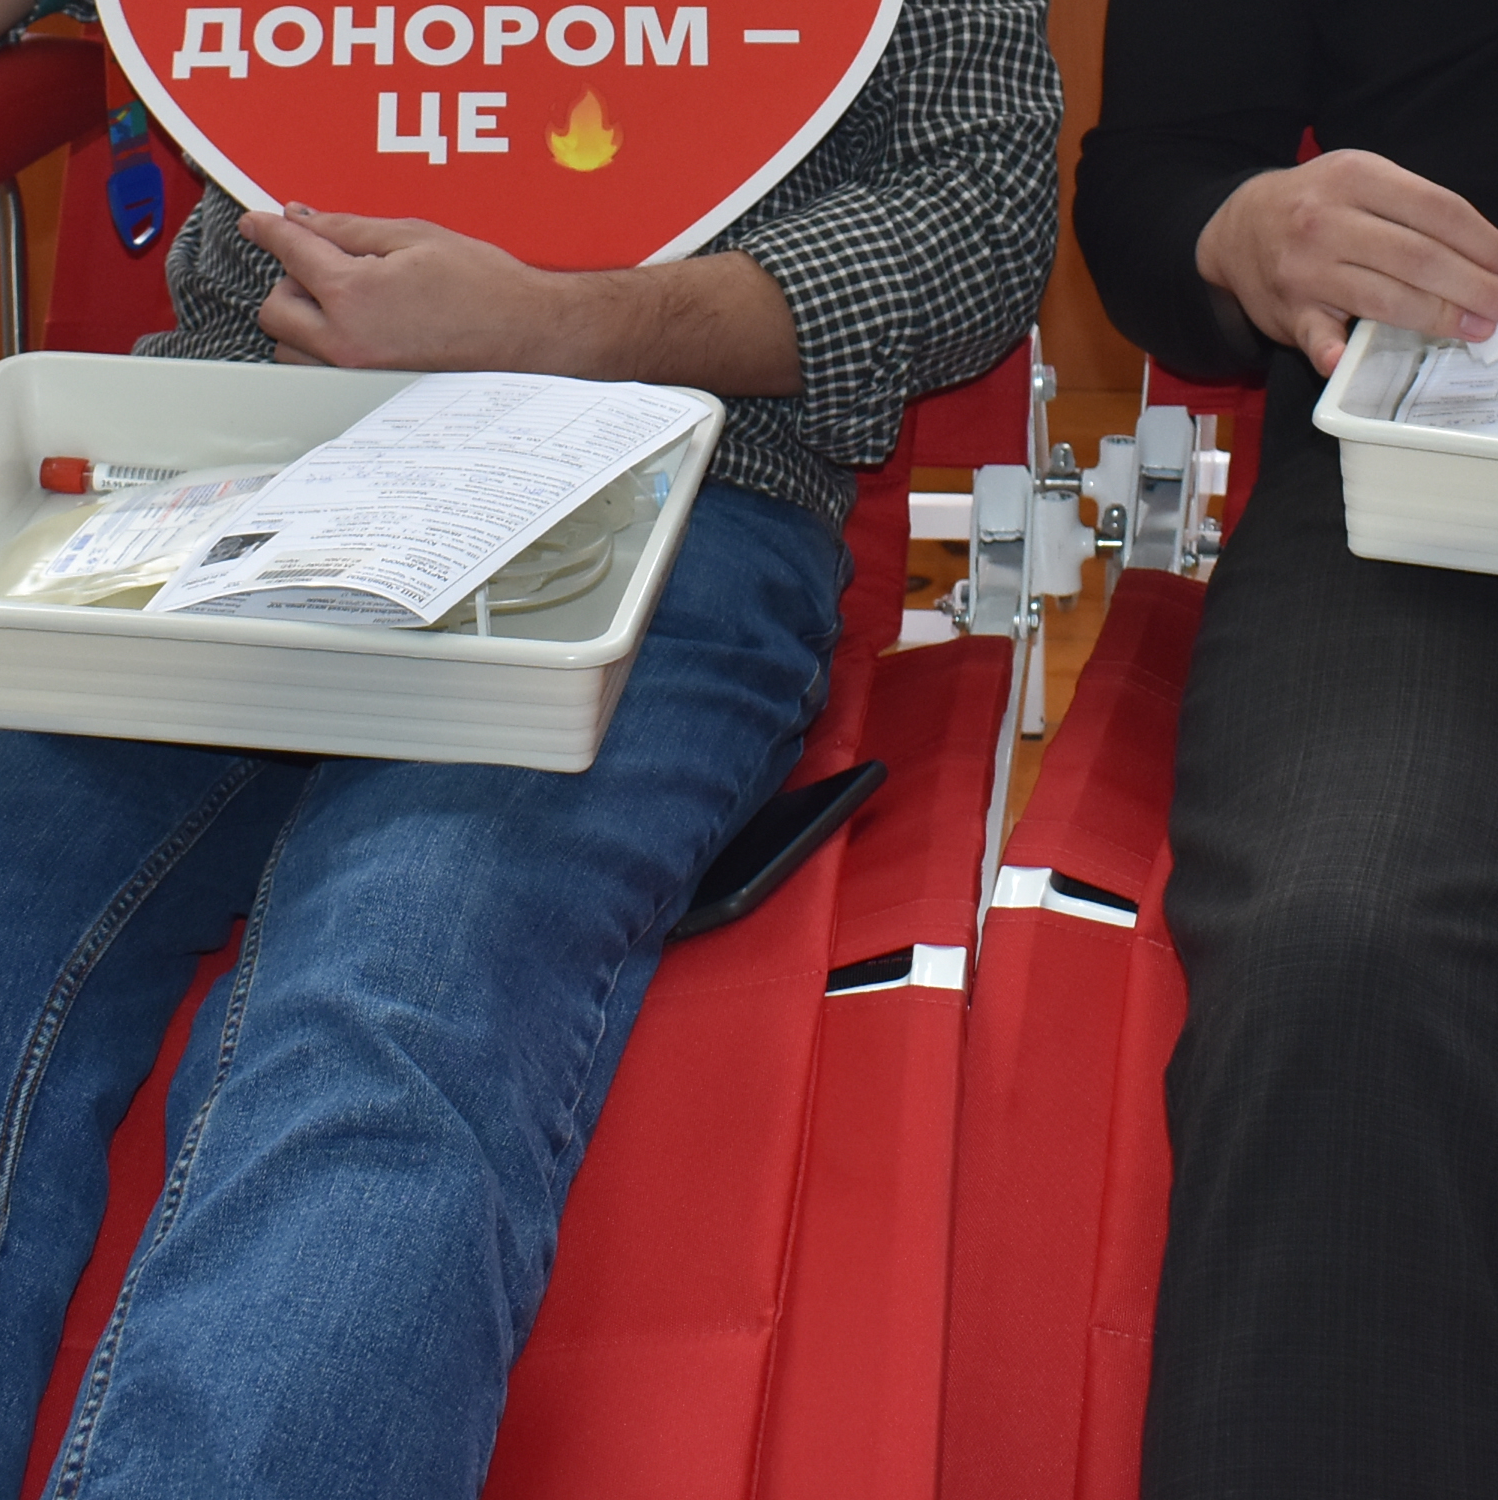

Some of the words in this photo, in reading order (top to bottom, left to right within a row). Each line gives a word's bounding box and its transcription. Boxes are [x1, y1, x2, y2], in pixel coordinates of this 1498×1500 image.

[171, 5, 709, 79] ДОНОРОМ
[376, 91, 510, 165] ЦЕ
[381, 557, 417, 568] ДОНОРА
[417, 566, 449, 582] КАРТКА
